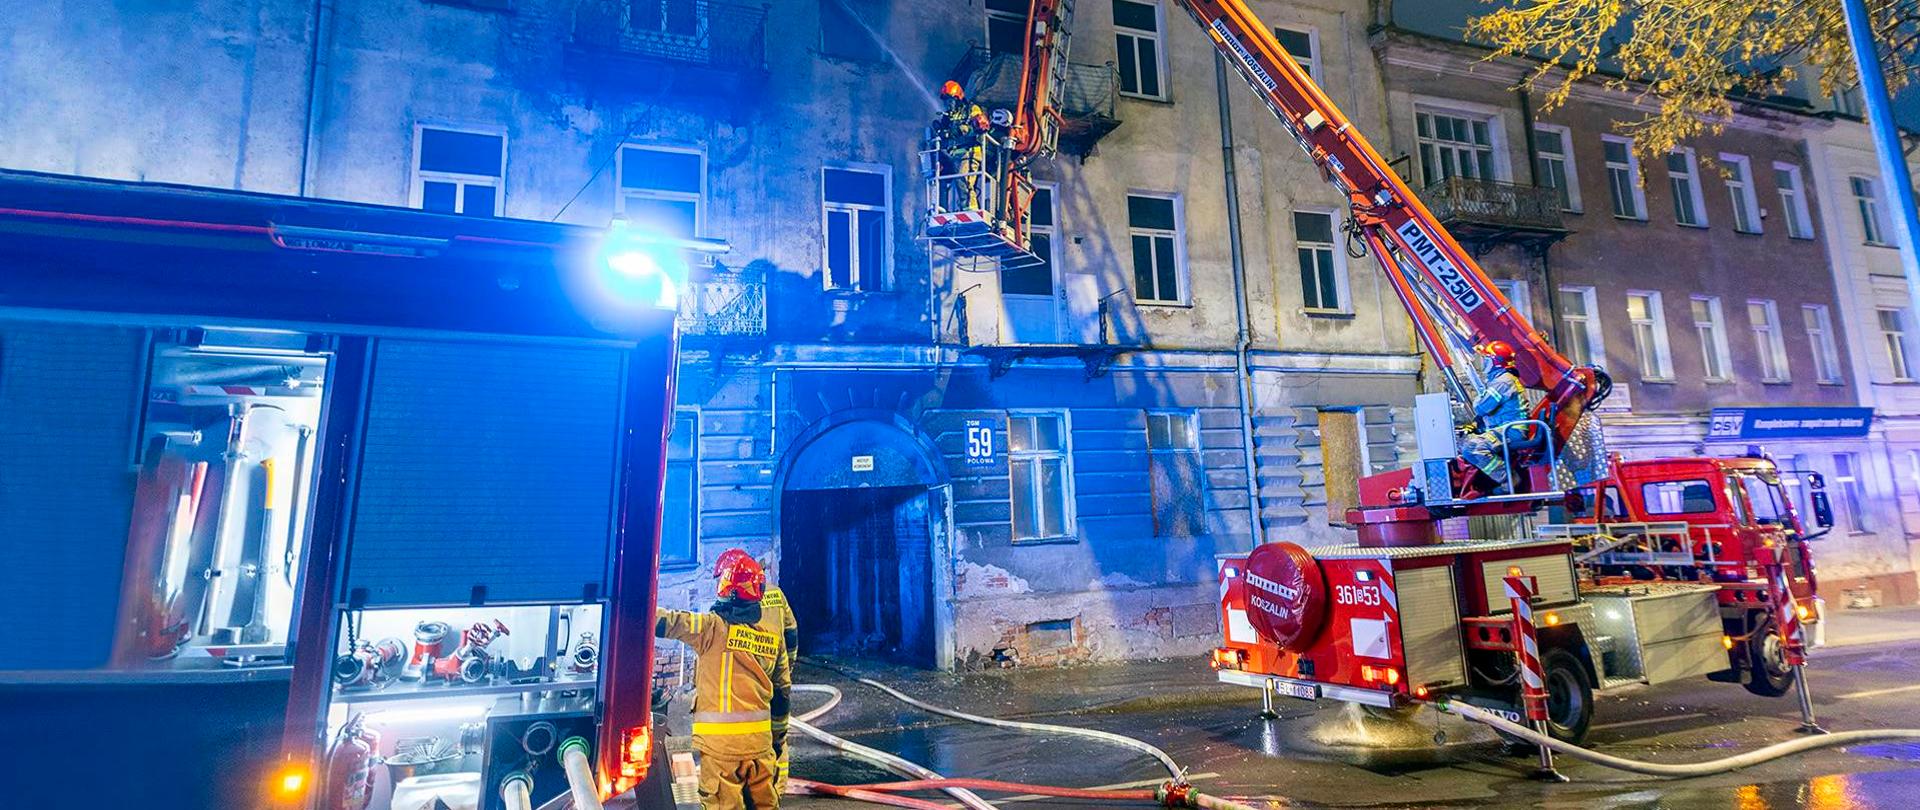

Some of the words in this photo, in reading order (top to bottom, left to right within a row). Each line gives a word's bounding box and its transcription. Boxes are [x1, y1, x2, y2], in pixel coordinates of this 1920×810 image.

[1243, 54, 1275, 89] KOSZALIN
[1402, 223, 1479, 307] PMT-25D
[1713, 420, 1742, 431] CSV
[968, 427, 991, 457] 59
[1251, 594, 1289, 619] KOSZALIN
